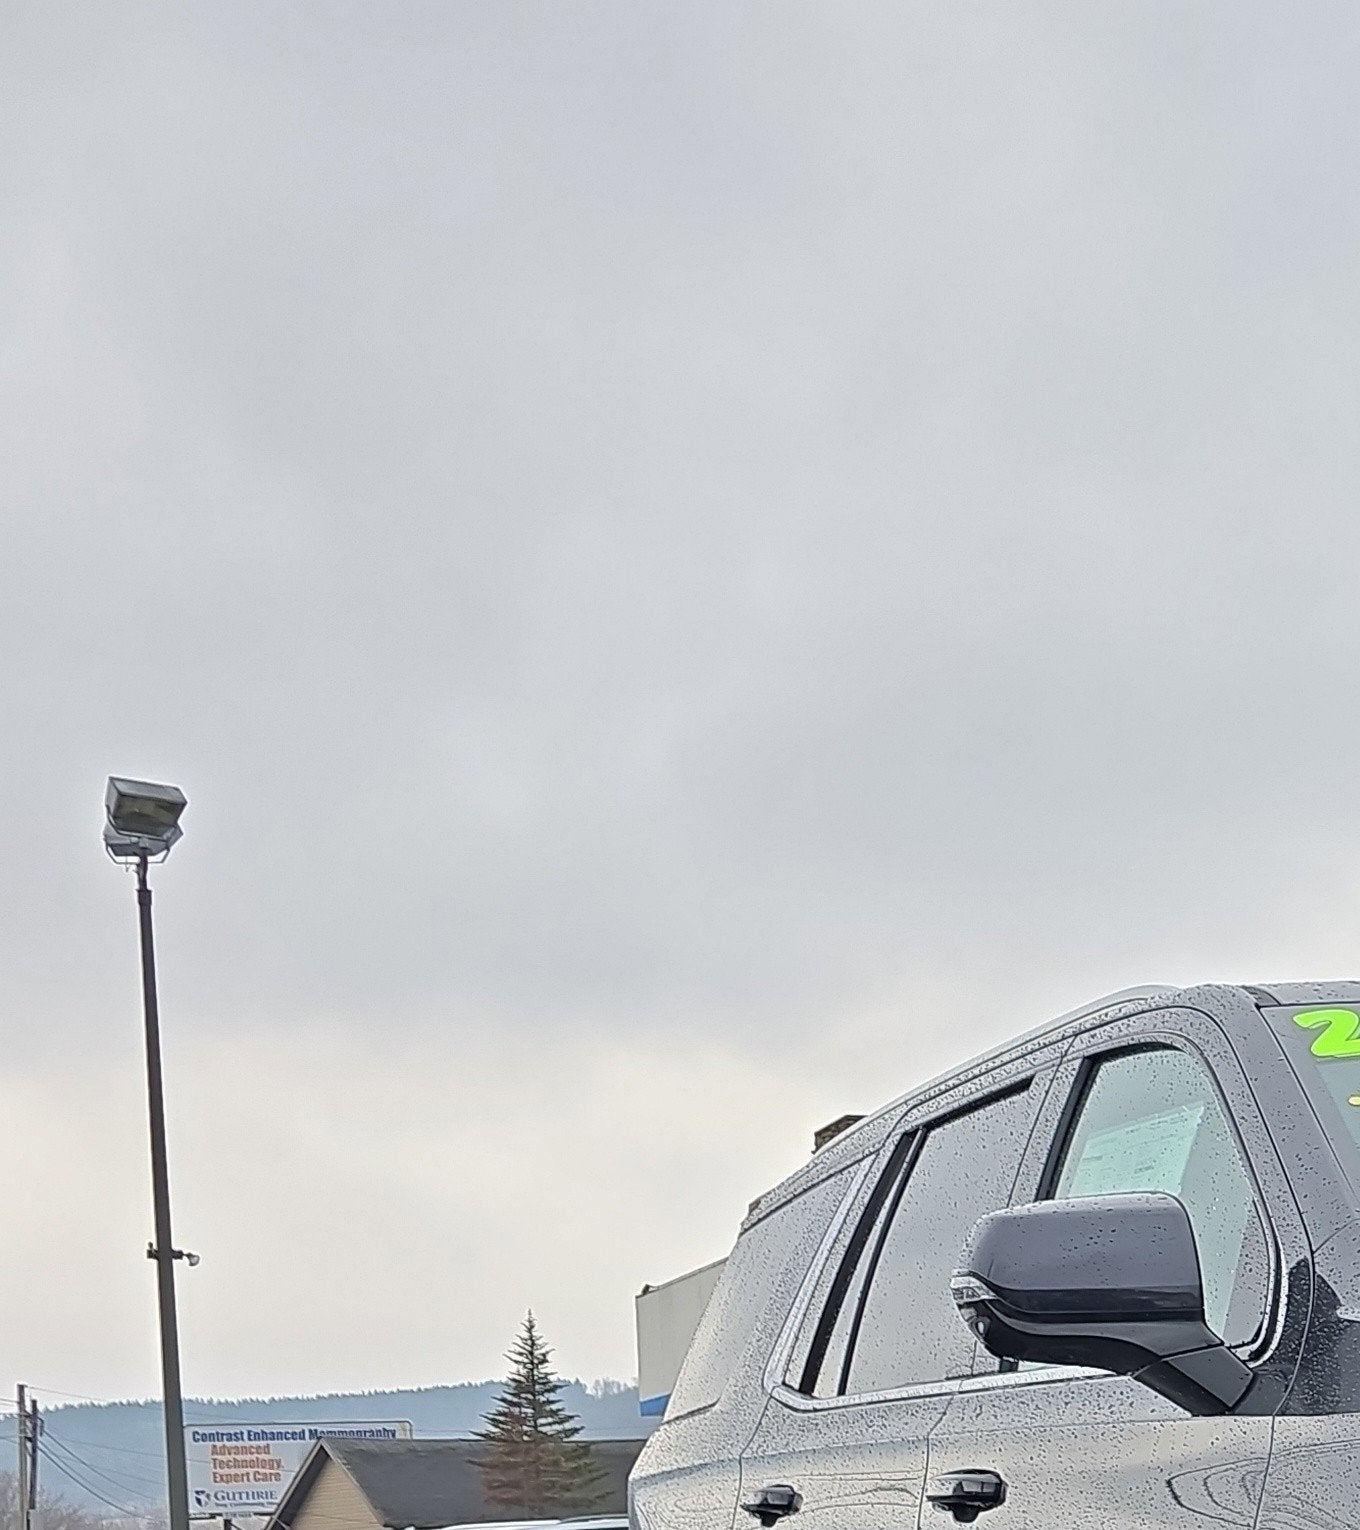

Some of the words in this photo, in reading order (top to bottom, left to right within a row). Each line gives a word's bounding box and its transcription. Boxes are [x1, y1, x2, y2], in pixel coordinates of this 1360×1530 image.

[192, 1431, 245, 1442] Contrast
[247, 1429, 306, 1441] Enhanced
[211, 1443, 271, 1456] Advanced
[212, 1472, 251, 1484] Expert
[253, 1470, 281, 1482] Care
